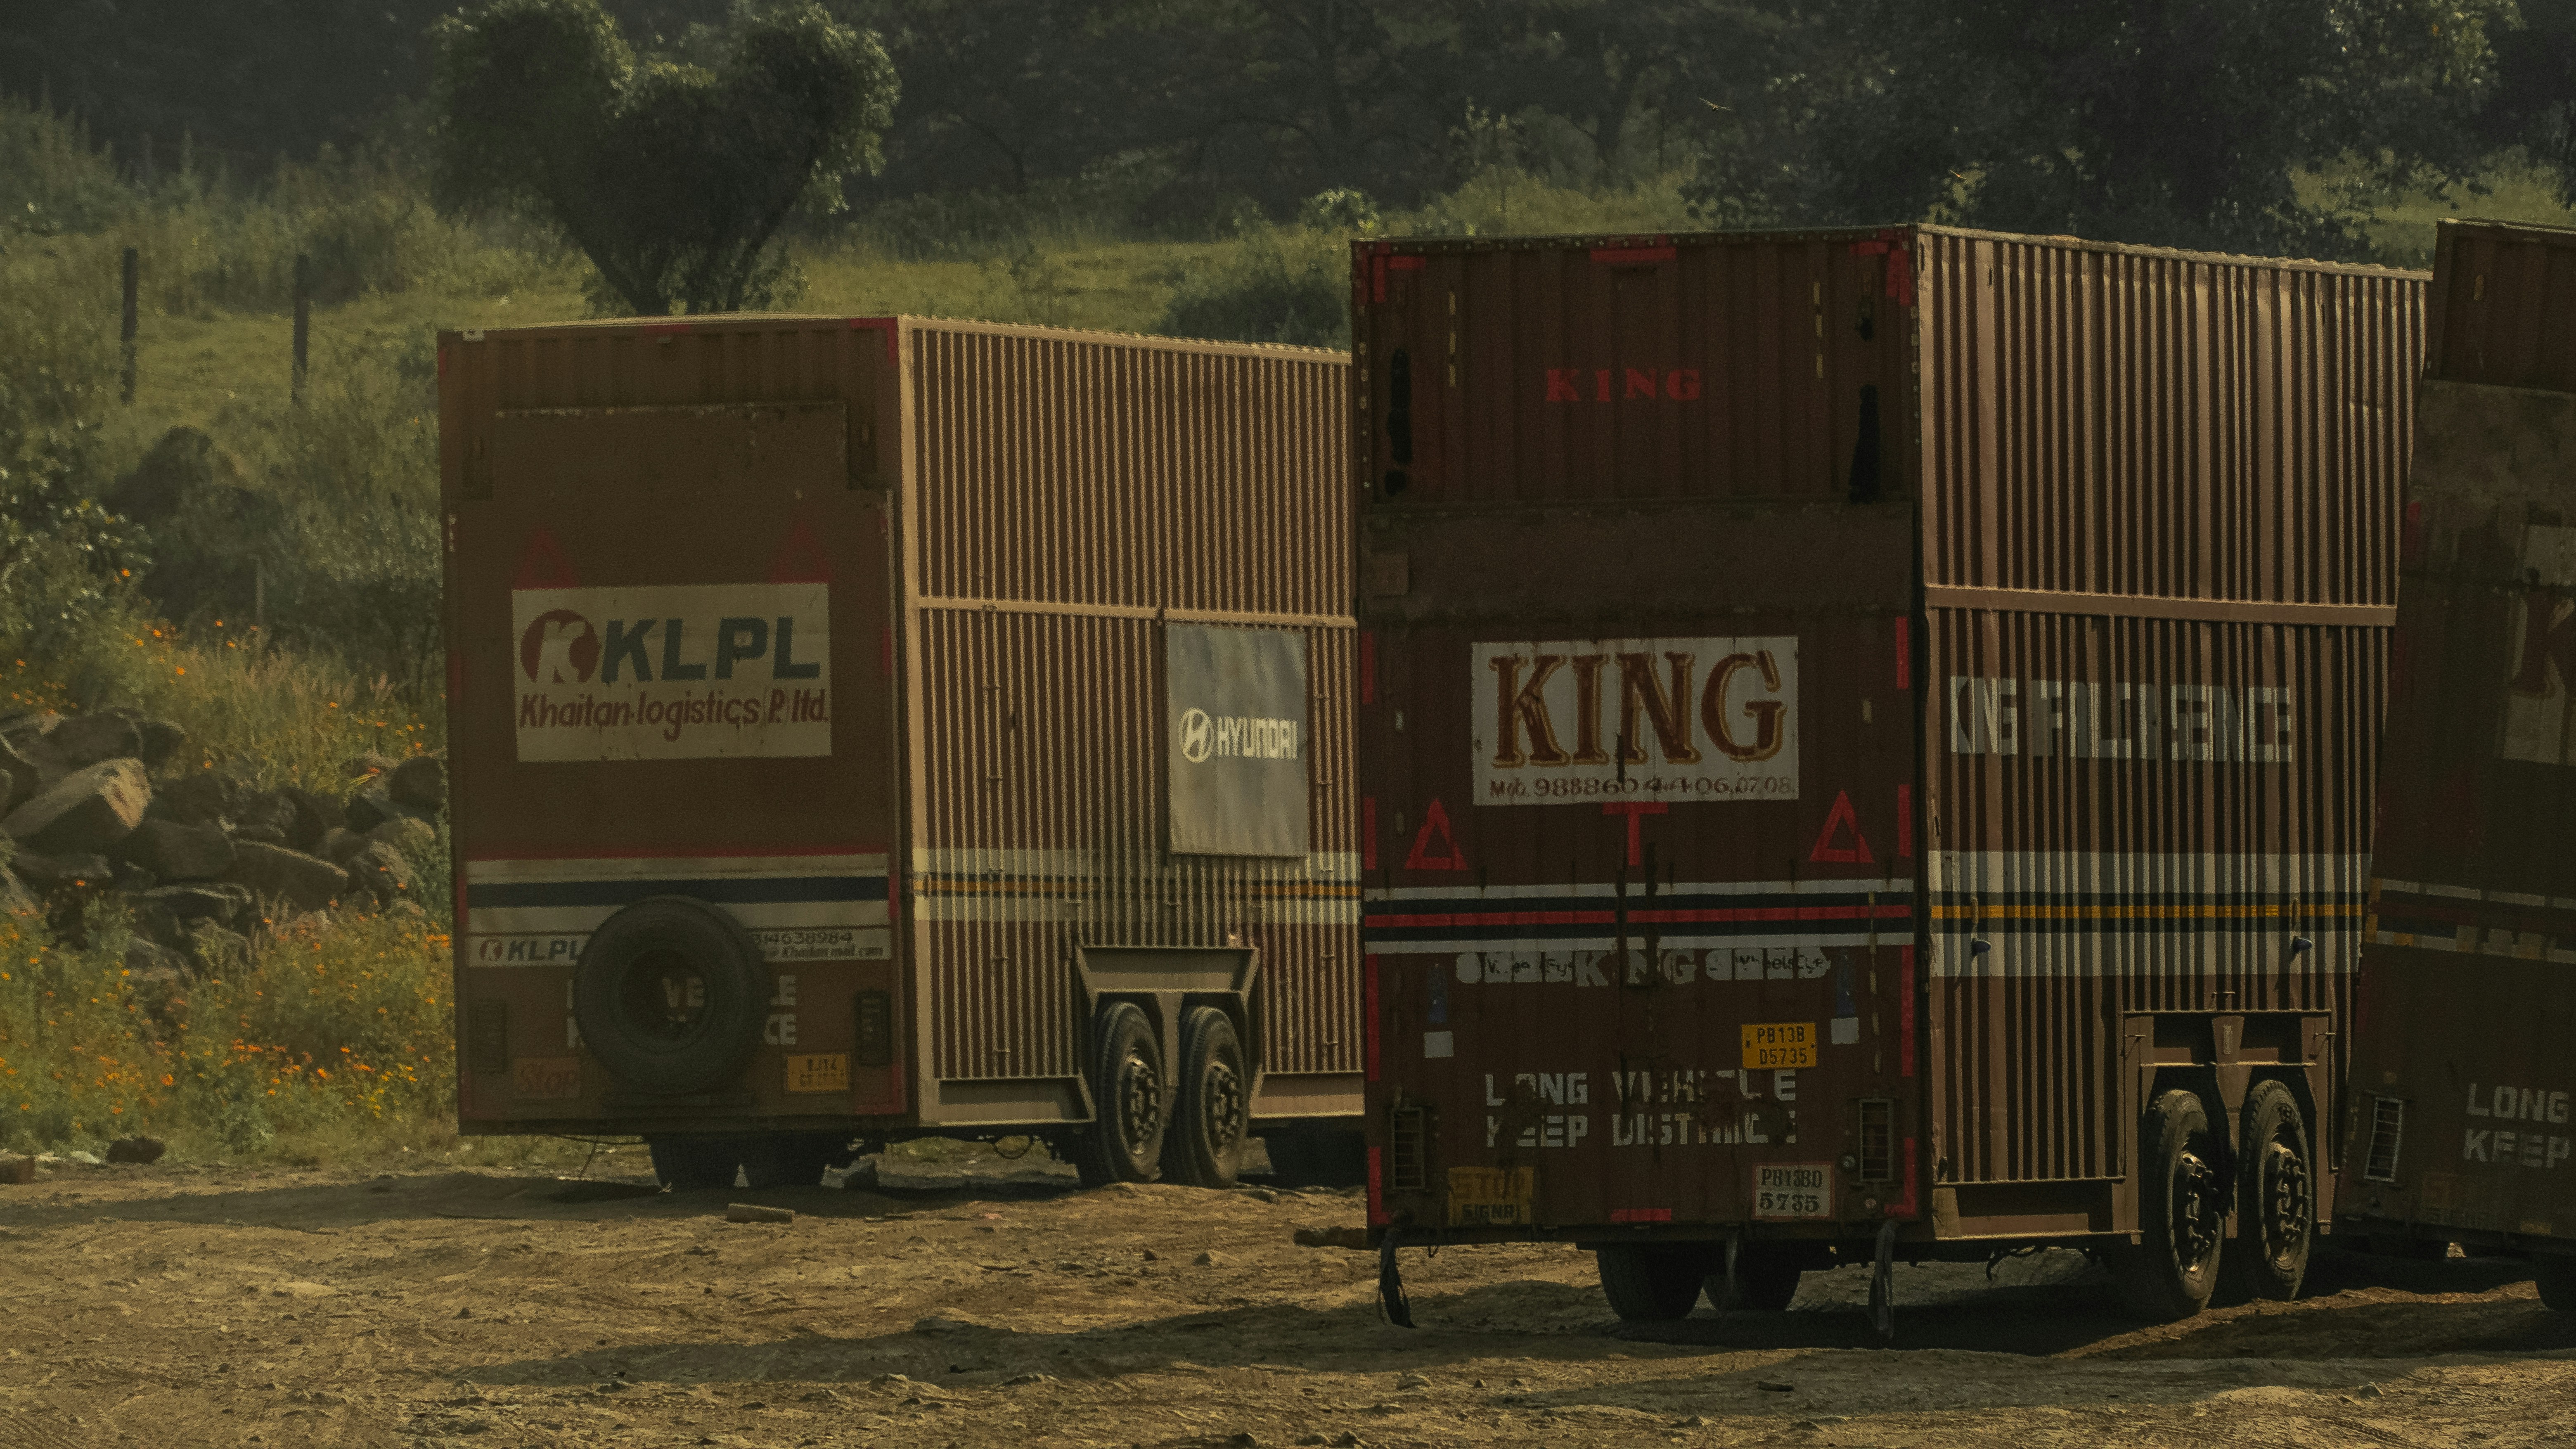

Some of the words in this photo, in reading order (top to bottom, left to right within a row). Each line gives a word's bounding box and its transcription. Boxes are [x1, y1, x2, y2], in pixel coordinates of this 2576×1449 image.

[1546, 369, 1700, 402] KING
[601, 616, 822, 684] KLPL
[1489, 650, 1788, 768] KING
[1217, 716, 1298, 760] HYUNDAI
[1757, 1026, 1805, 1044] PB13B
[1759, 1047, 1808, 1065] D5735
[2465, 1082, 2570, 1124] LONG
[1759, 1192, 1820, 1212] 5735
